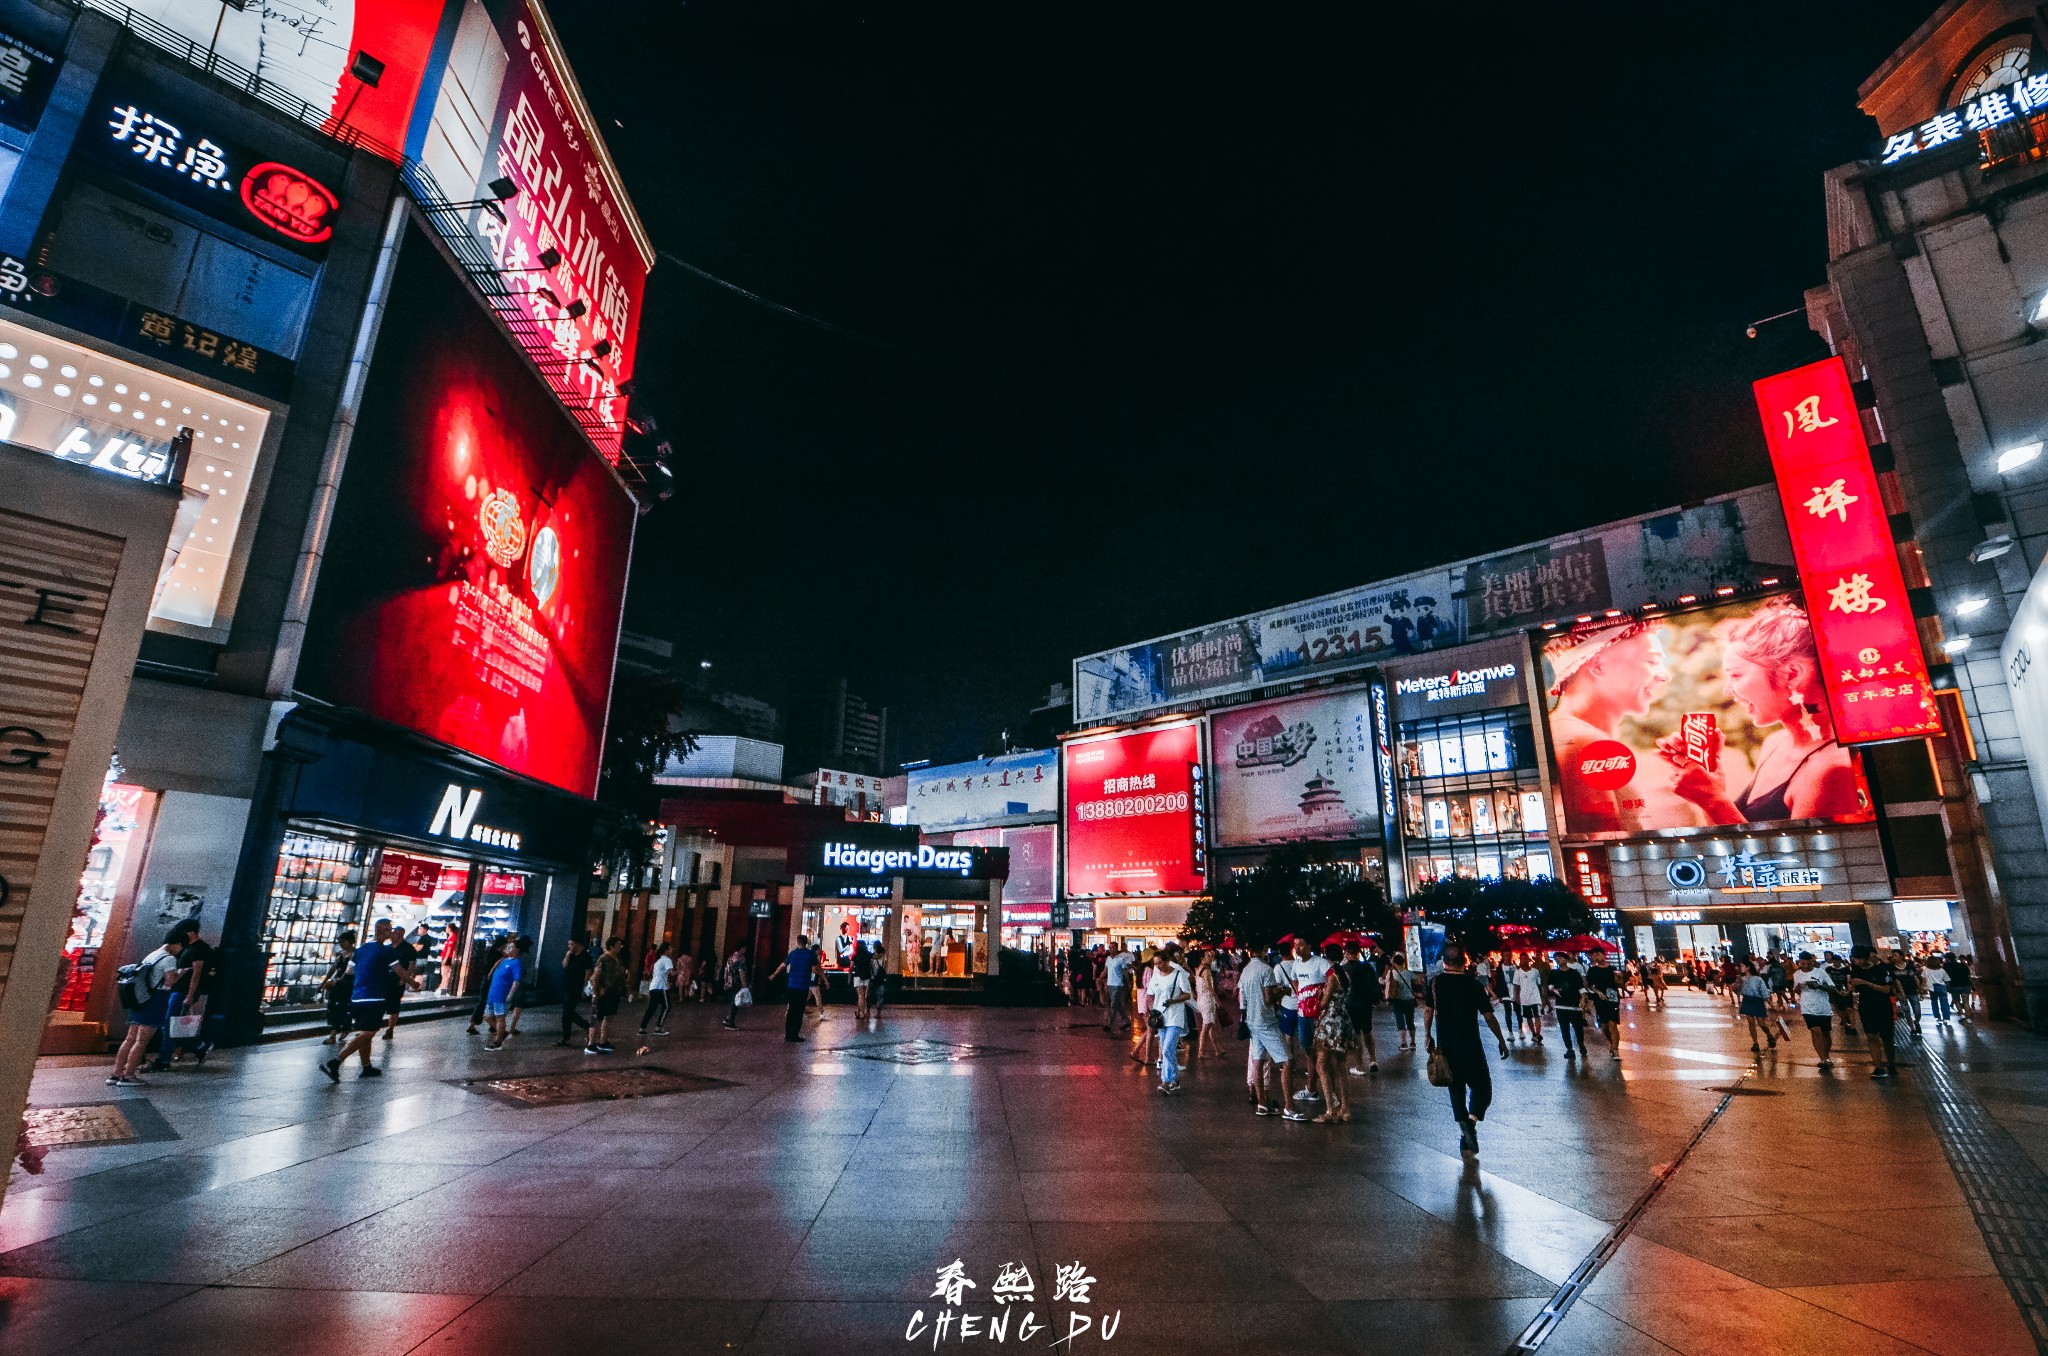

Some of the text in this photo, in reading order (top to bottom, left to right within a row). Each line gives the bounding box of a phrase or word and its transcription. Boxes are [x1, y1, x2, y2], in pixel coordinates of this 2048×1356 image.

[530, 51, 565, 117] GREE
[253, 193, 315, 236] TAN YU
[502, 91, 630, 345] 晶弘冰箱
[140, 310, 261, 375] 黄记煌
[1171, 633, 1243, 667] 优雅时尚
[1297, 625, 1384, 666] 12315
[1171, 655, 1243, 688] 品位锦江
[1427, 680, 1486, 702] 美特斯邦威
[1844, 683, 1914, 703] 百年老店
[821, 770, 883, 792] 鹏爱悦己
[916, 764, 1045, 798] 文明城市共建共享
[1580, 755, 1633, 775] 可口可乐
[1103, 774, 1156, 795] 招商热线
[428, 783, 483, 840] N
[1076, 792, 1189, 821] 13880200200
[1655, 911, 1700, 922] BOLON
